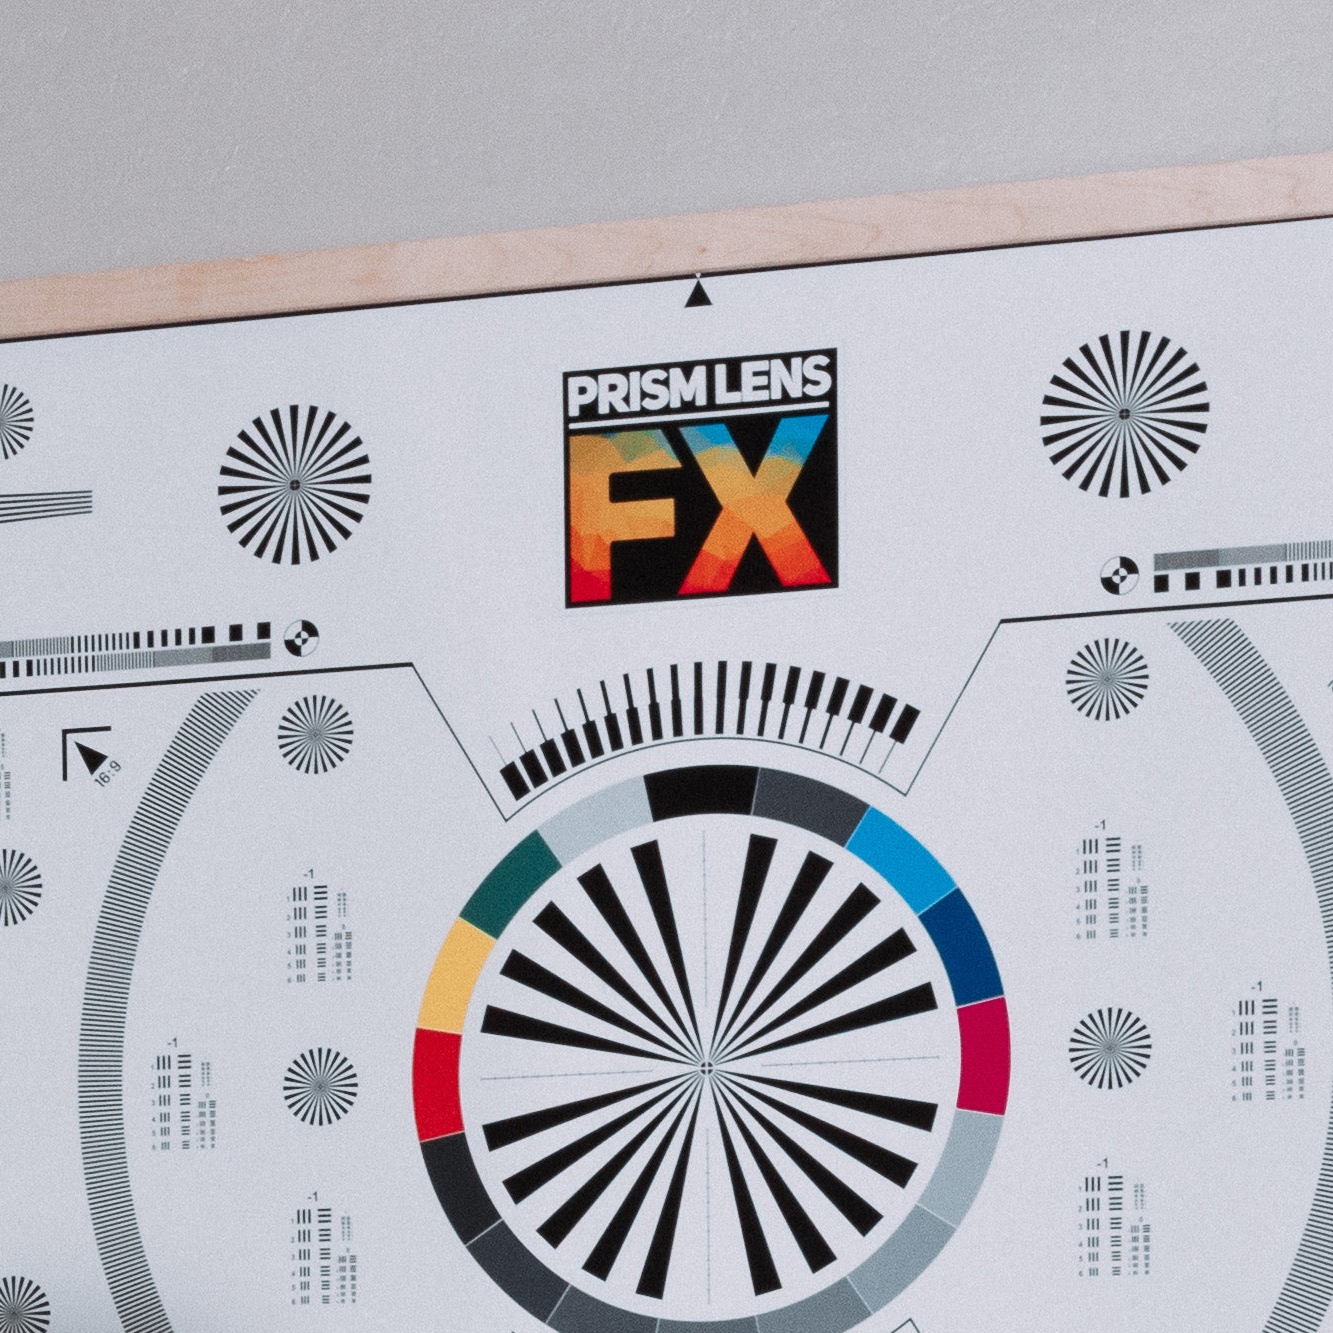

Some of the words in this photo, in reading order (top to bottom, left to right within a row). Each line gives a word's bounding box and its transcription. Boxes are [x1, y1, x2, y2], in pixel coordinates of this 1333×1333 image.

[568, 365, 707, 417] PRISM
[715, 355, 832, 404] LENS
[569, 414, 832, 602] FX
[94, 760, 122, 788] 16:9
